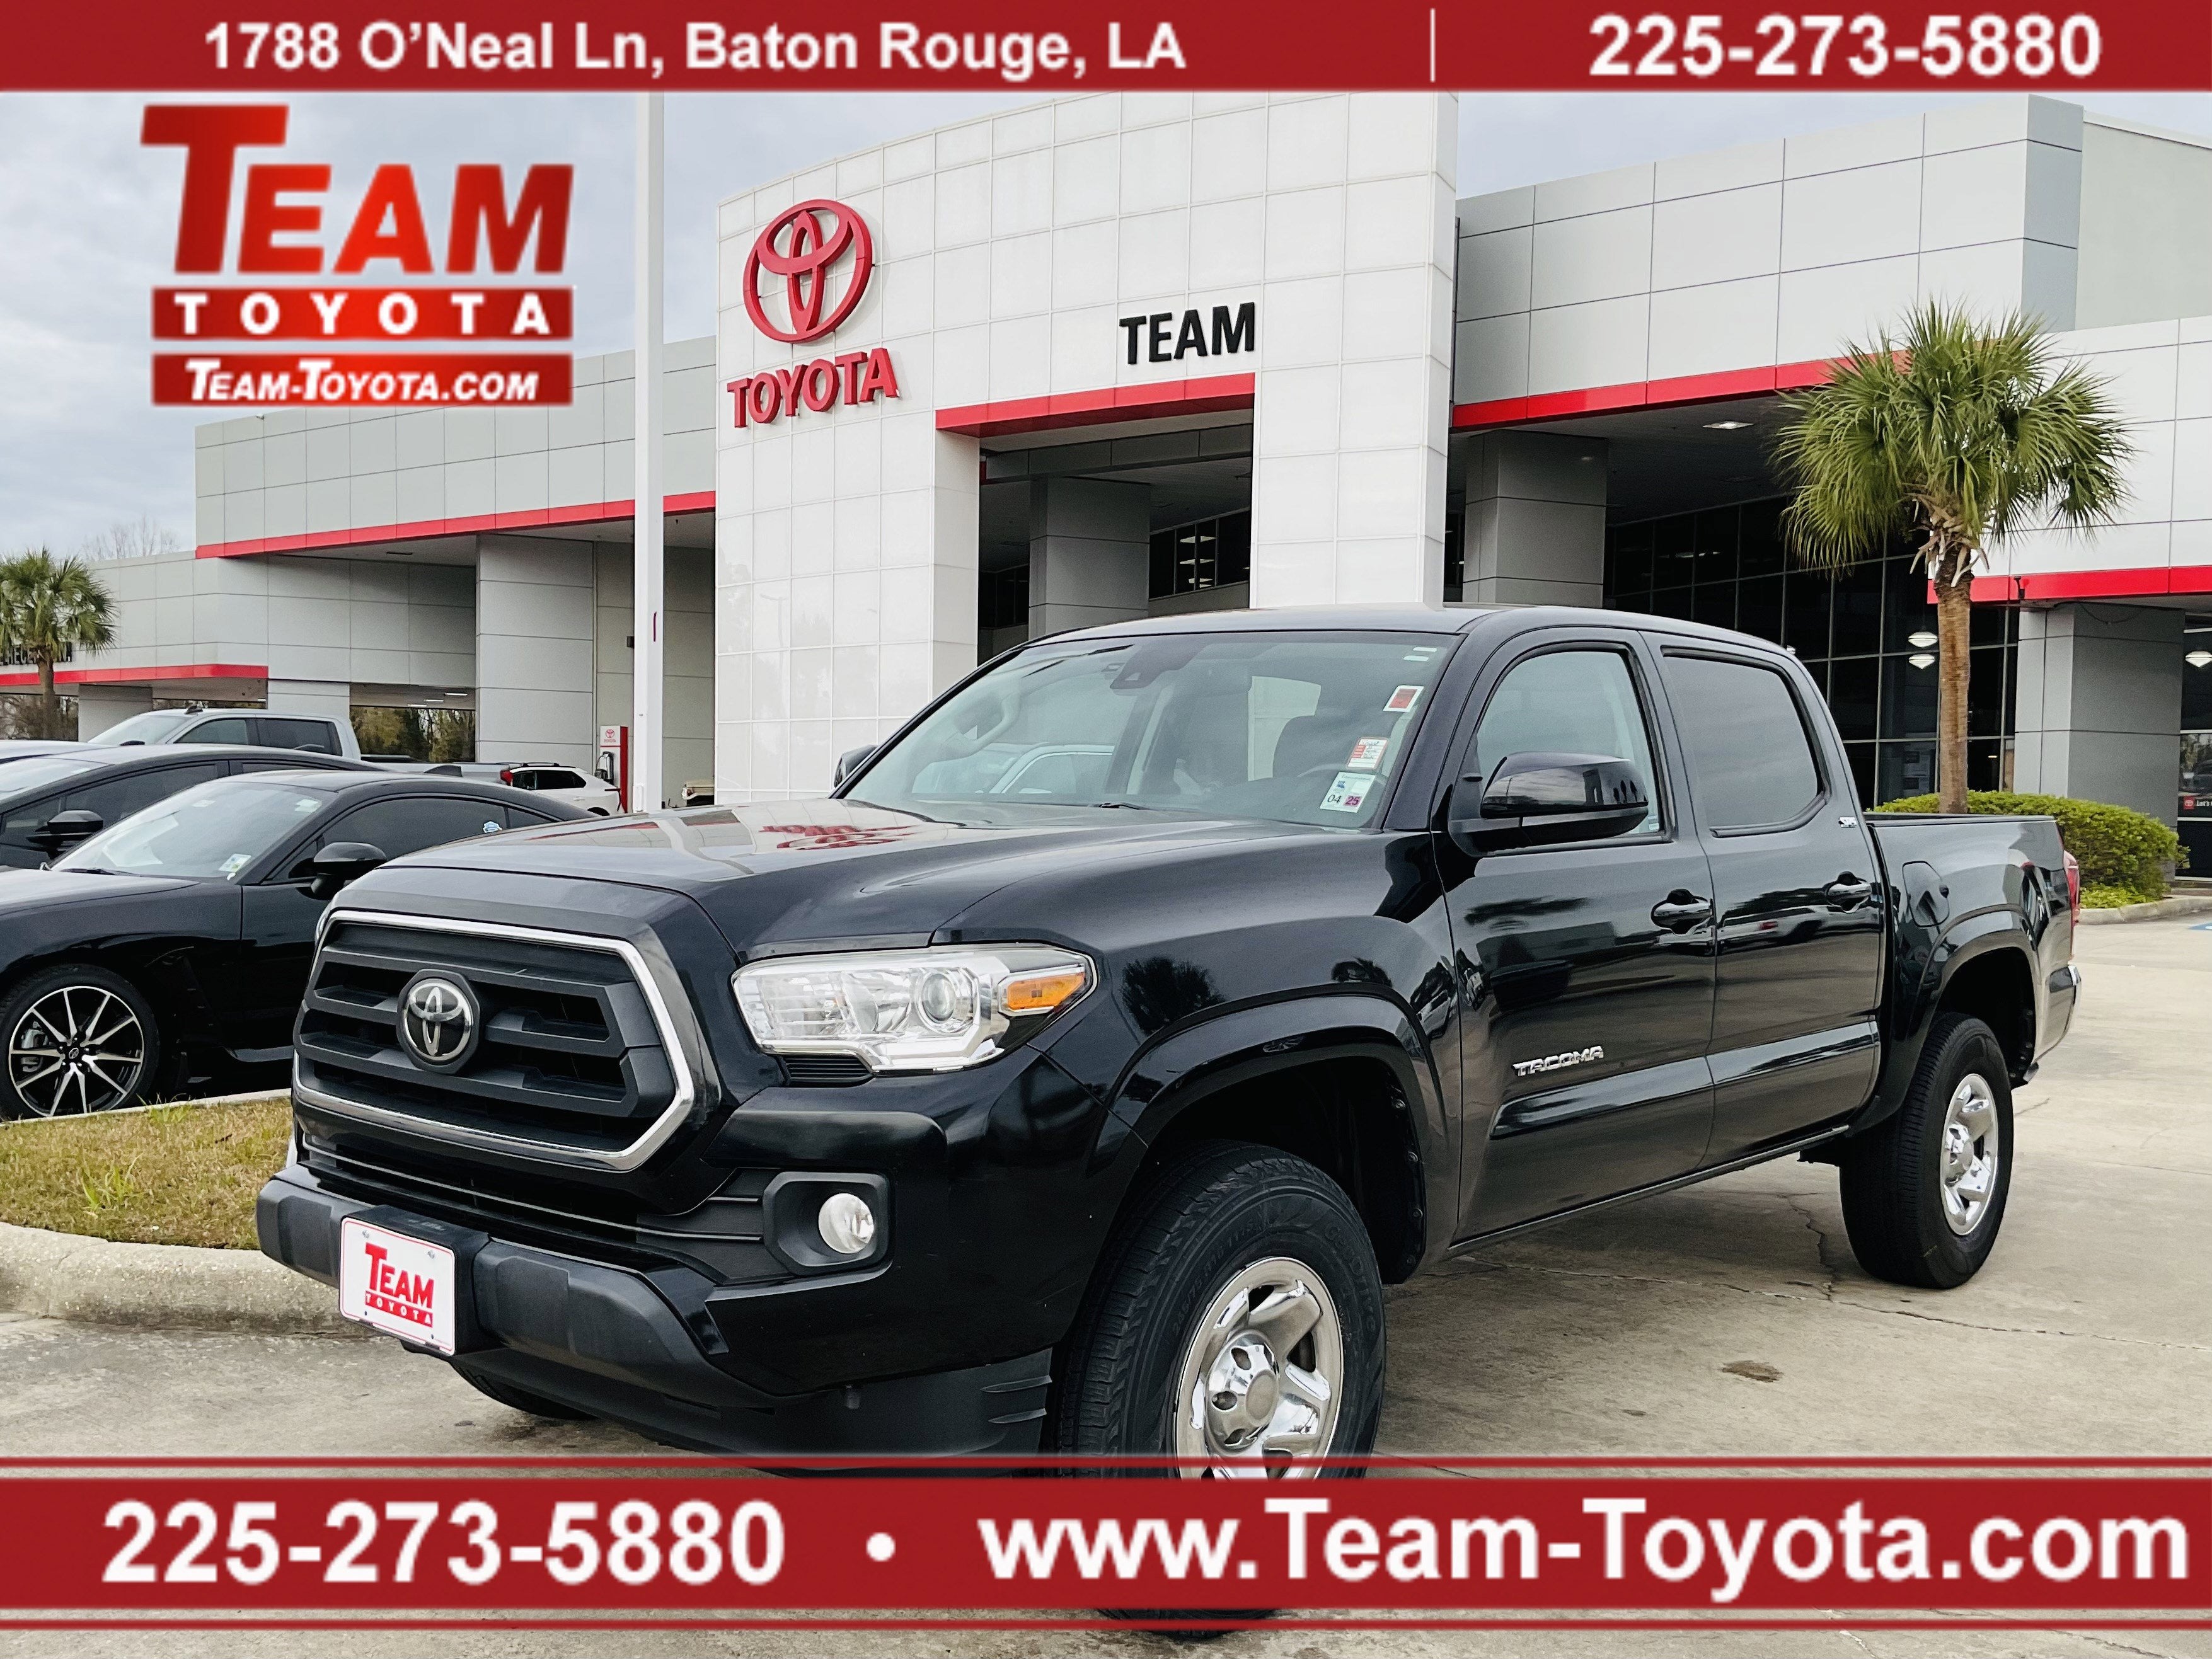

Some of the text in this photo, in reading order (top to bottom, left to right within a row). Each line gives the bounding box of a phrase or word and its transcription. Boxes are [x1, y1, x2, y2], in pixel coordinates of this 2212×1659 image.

[1119, 302, 1256, 365] TEAM
[727, 347, 900, 428] TOYOTA
[1327, 794, 1361, 806] 04 25
[1512, 1045, 1604, 1077] TACOMA
[364, 1242, 435, 1309] TEAM
[365, 1294, 434, 1325] TOYOTA
